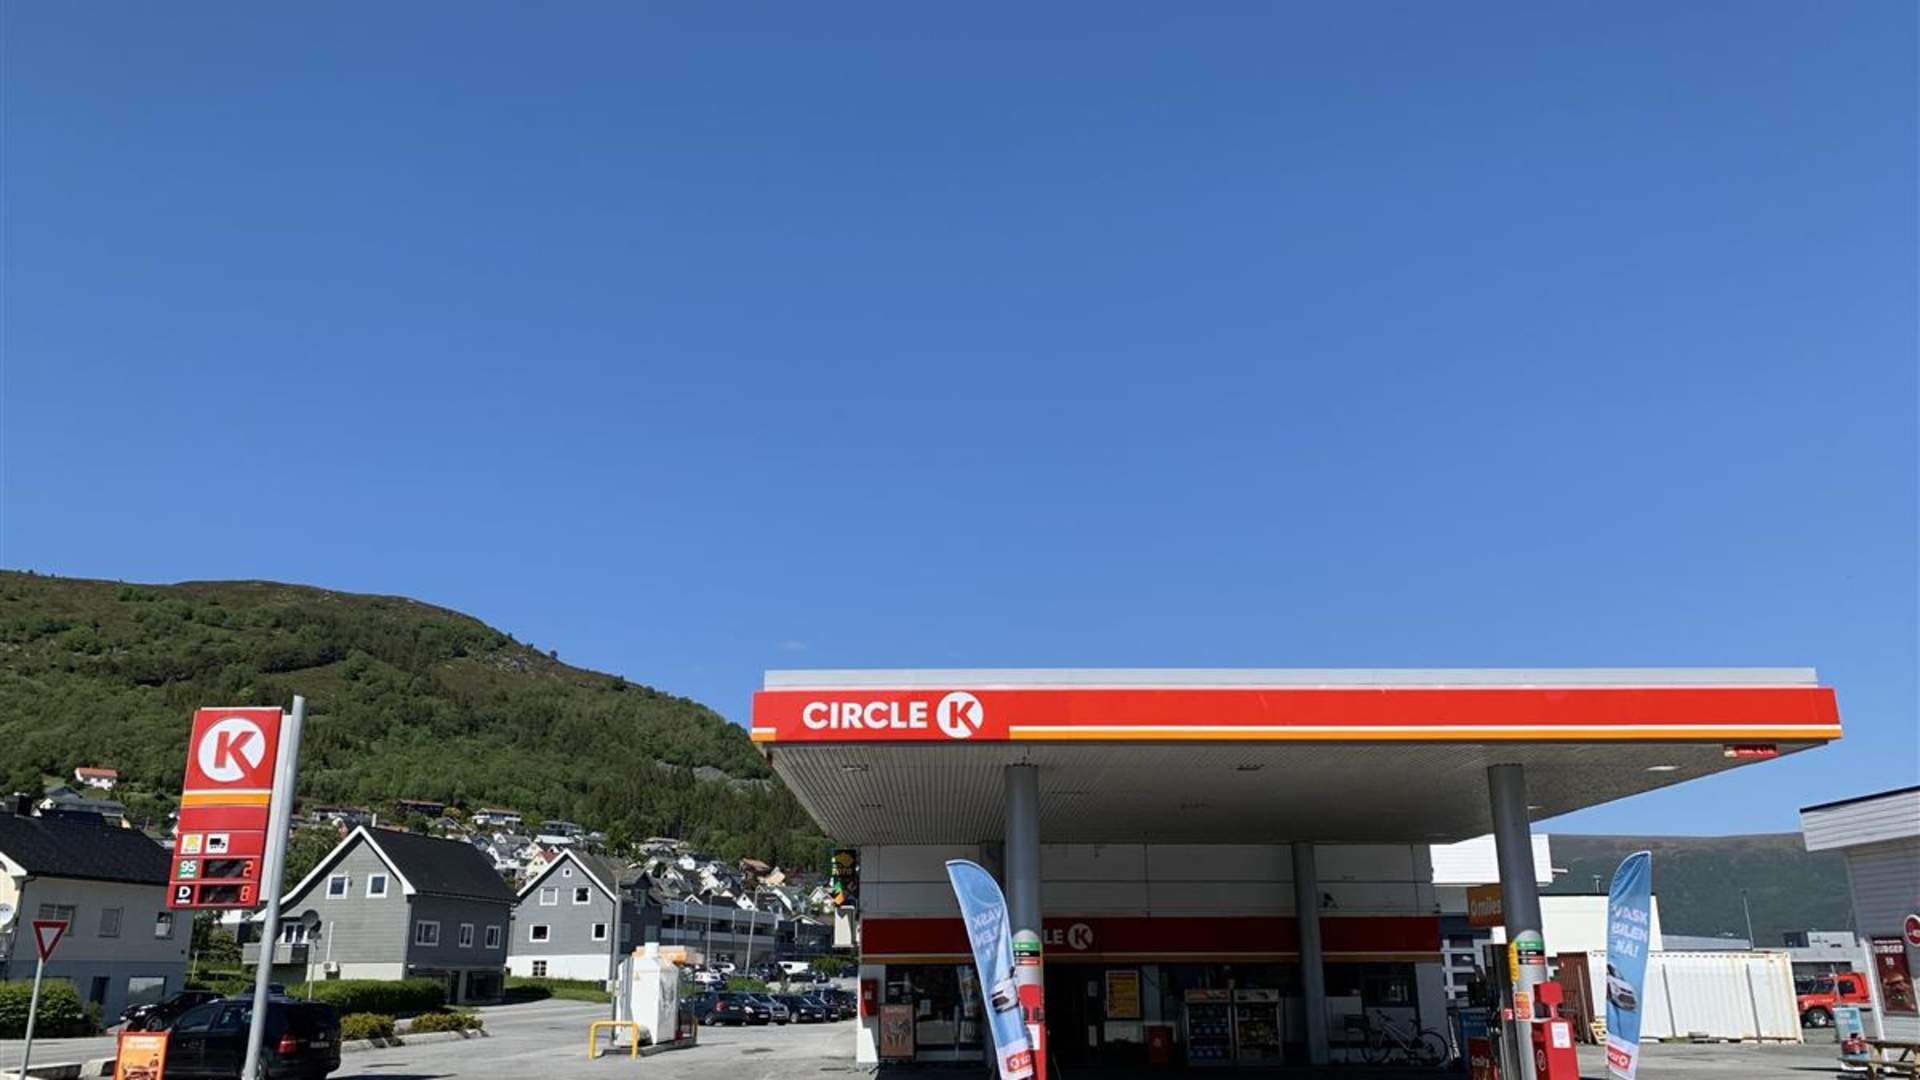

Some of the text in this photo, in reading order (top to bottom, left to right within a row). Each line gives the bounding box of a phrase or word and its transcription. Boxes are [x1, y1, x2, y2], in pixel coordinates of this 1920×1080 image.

[803, 702, 928, 729] CIRCLE
[179, 861, 197, 873] 95
[178, 886, 191, 898] D
[1612, 904, 1648, 926] VASK
